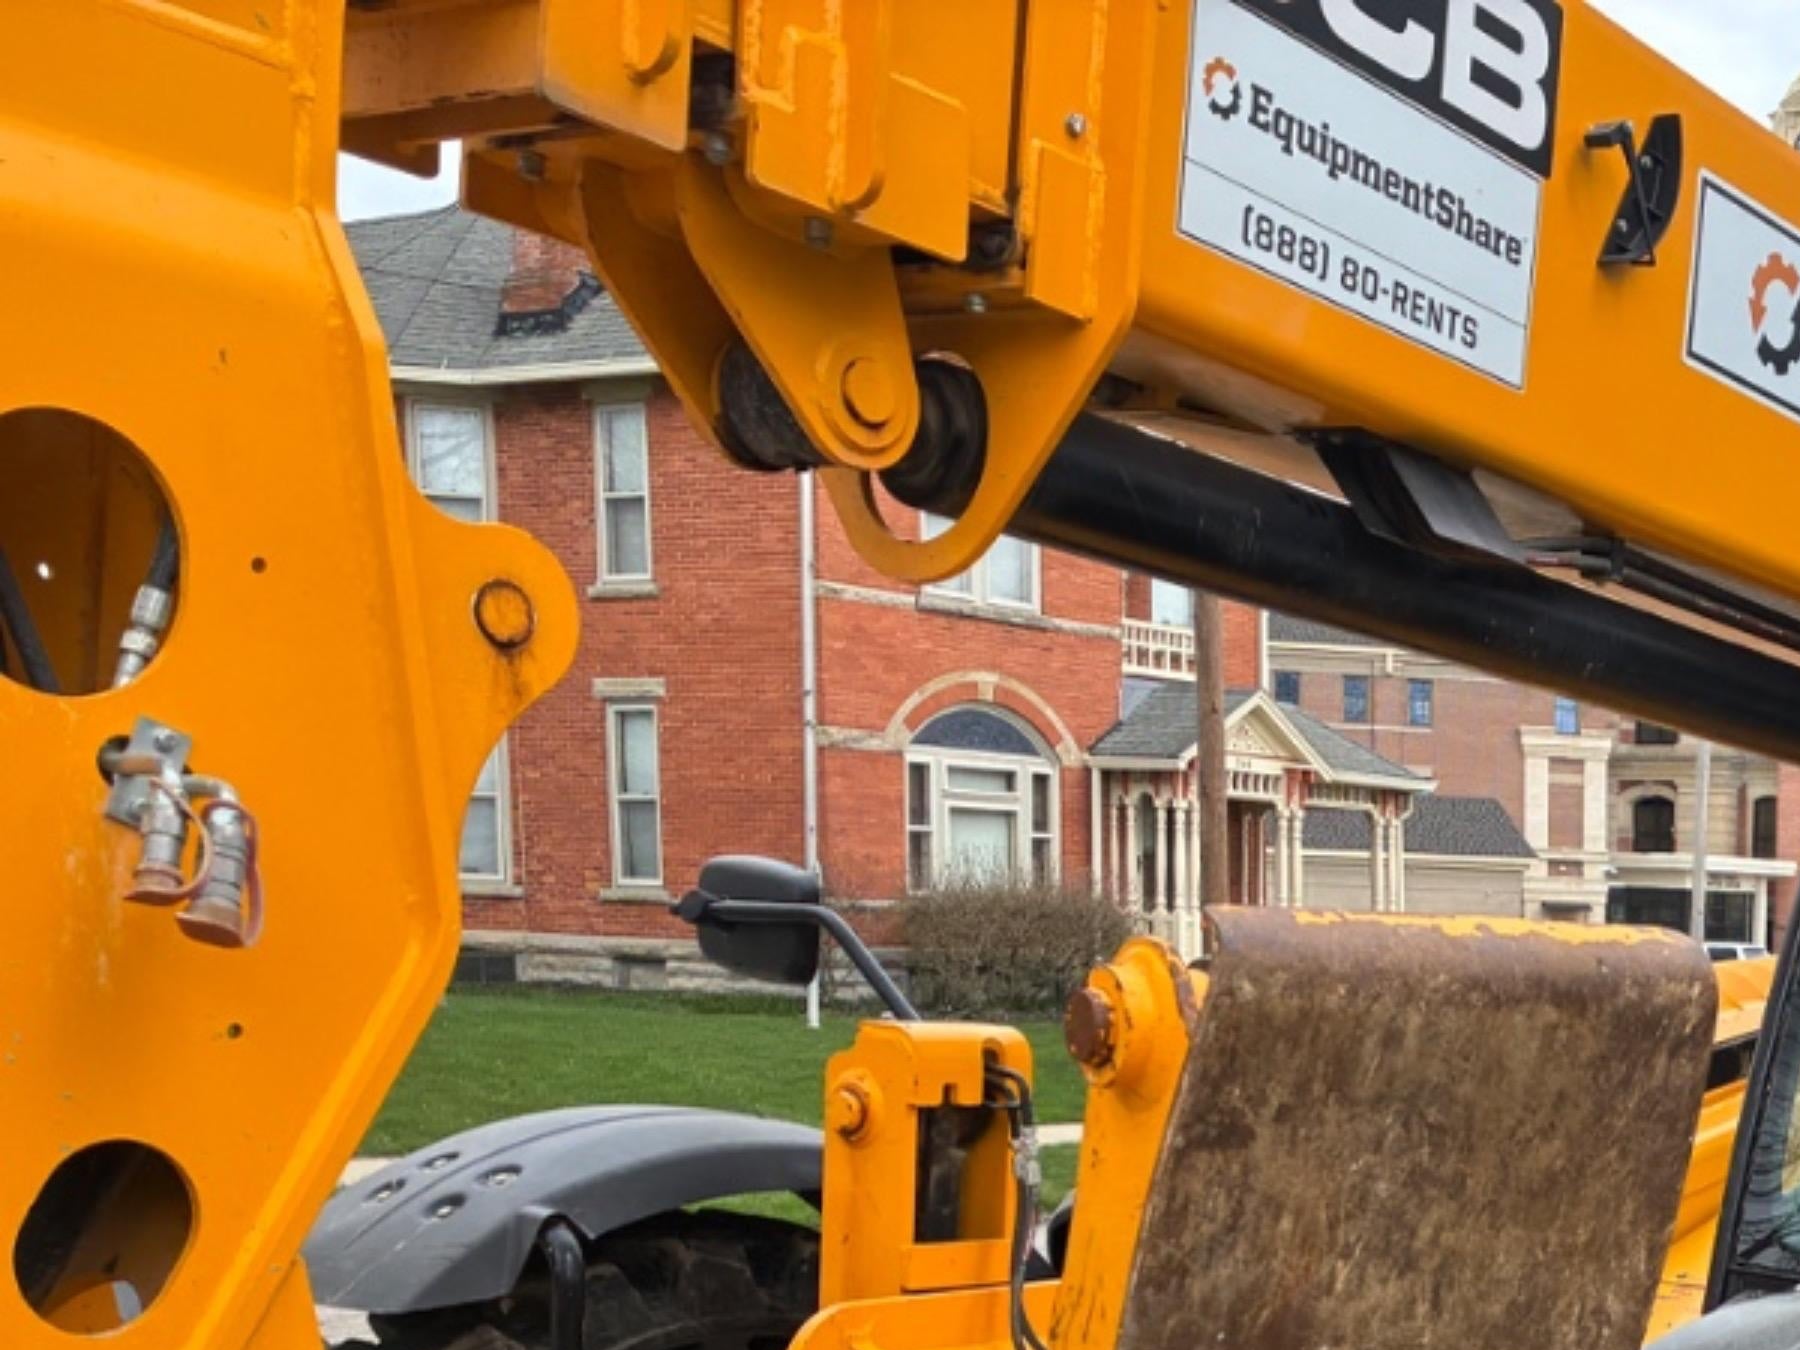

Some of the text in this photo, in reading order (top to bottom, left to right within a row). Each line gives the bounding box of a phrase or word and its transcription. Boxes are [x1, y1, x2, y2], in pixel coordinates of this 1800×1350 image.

[1247, 83, 1523, 266] EquipmentShare
[1241, 204, 1479, 350] (888) 80-RENTS
